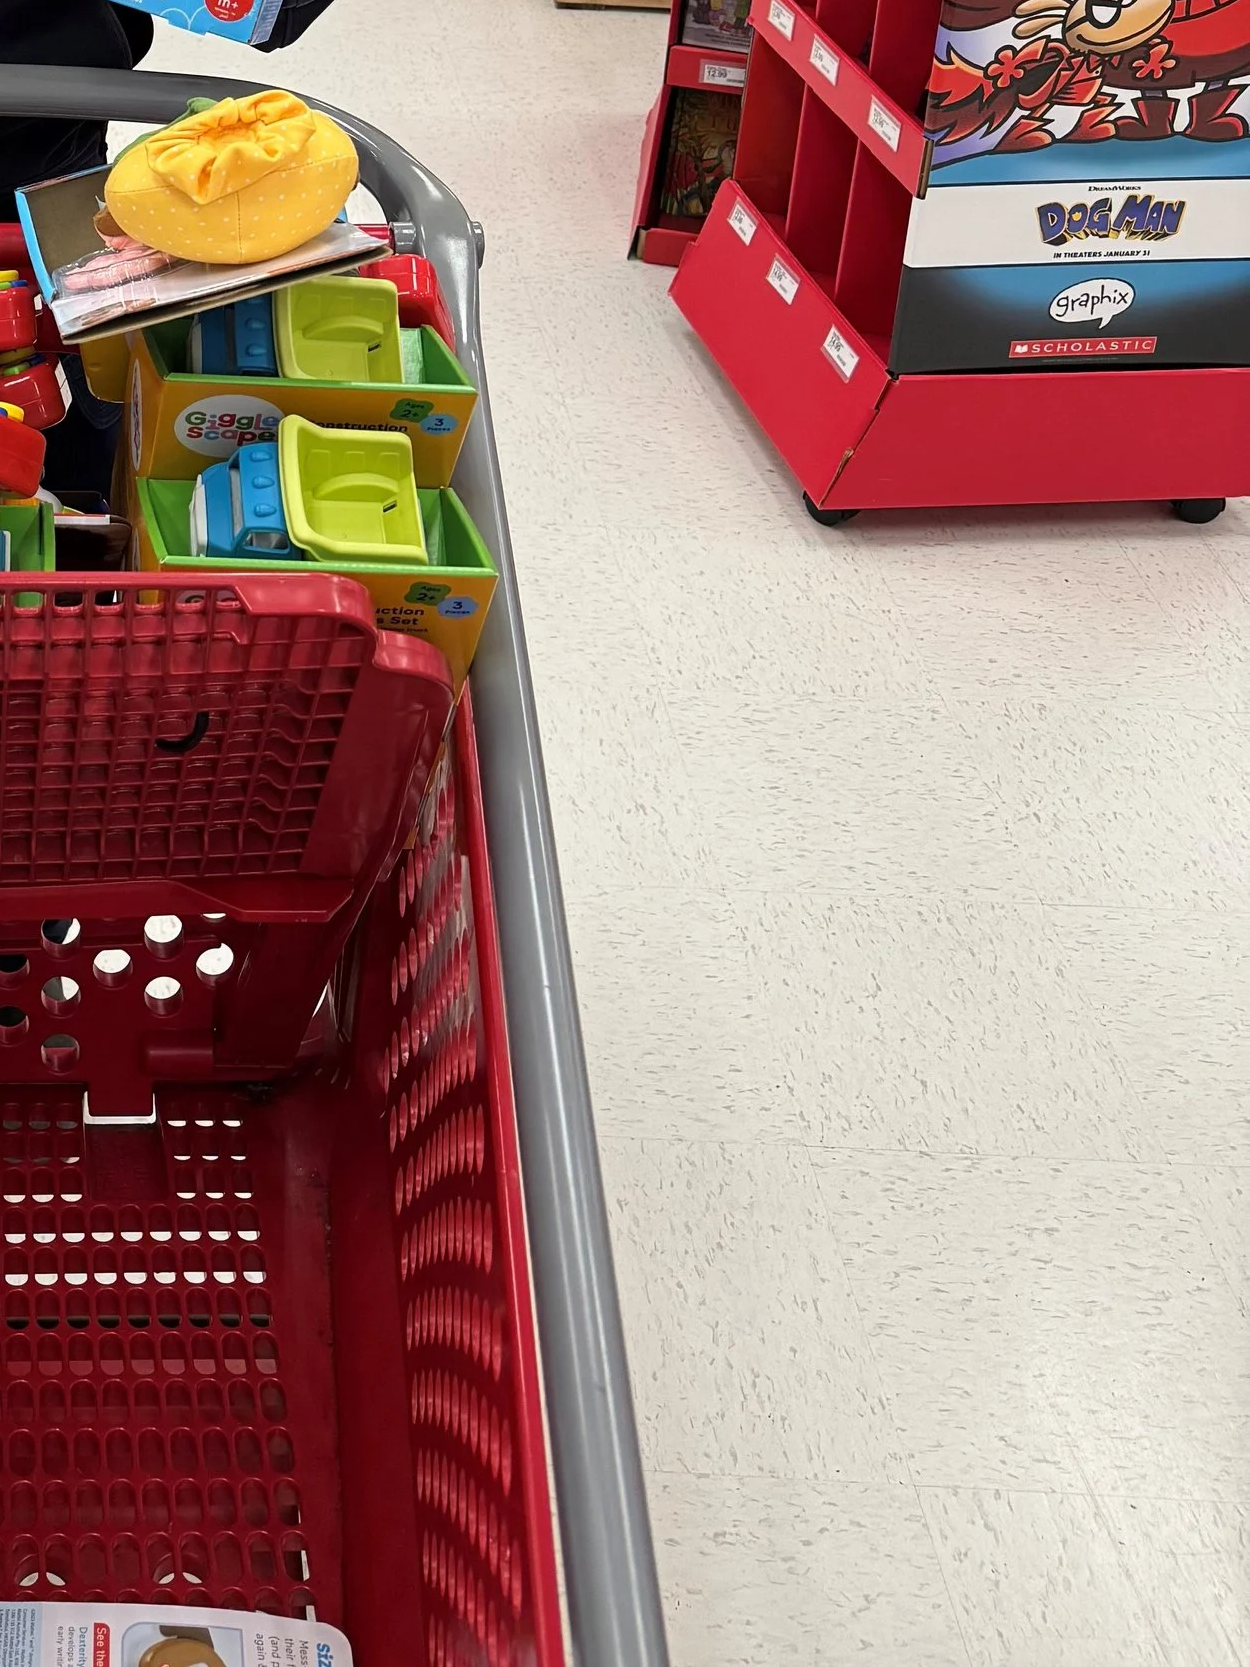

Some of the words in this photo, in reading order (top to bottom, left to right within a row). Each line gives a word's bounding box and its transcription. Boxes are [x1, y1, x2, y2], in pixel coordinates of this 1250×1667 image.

[1035, 196, 1113, 247] DOG
[1112, 192, 1187, 242] MAN
[1063, 251, 1102, 259] THEATERS
[1103, 250, 1141, 258] JANUARY
[1142, 249, 1151, 257] 31
[1055, 284, 1129, 317] graphix
[1030, 339, 1153, 354] SCHOLASTIC
[405, 401, 425, 409] Ages
[184, 410, 278, 430] Giggle
[400, 409, 420, 419] 2+
[310, 419, 408, 433] onstruction
[434, 418, 444, 427] 3
[416, 592, 436, 601] 2+
[420, 585, 442, 593] Ages
[375, 606, 425, 616] uction
[453, 601, 463, 610] 3
[389, 615, 418, 626] Set
[56, 1626, 64, 1644] early
[96, 1627, 105, 1647] See
[66, 1626, 74, 1661] develops
[77, 1626, 87, 1666] Dexterity
[254, 1633, 265, 1660] again
[268, 1636, 280, 1658] (and
[284, 1638, 294, 1660] their
[96, 1650, 104, 1666] the
